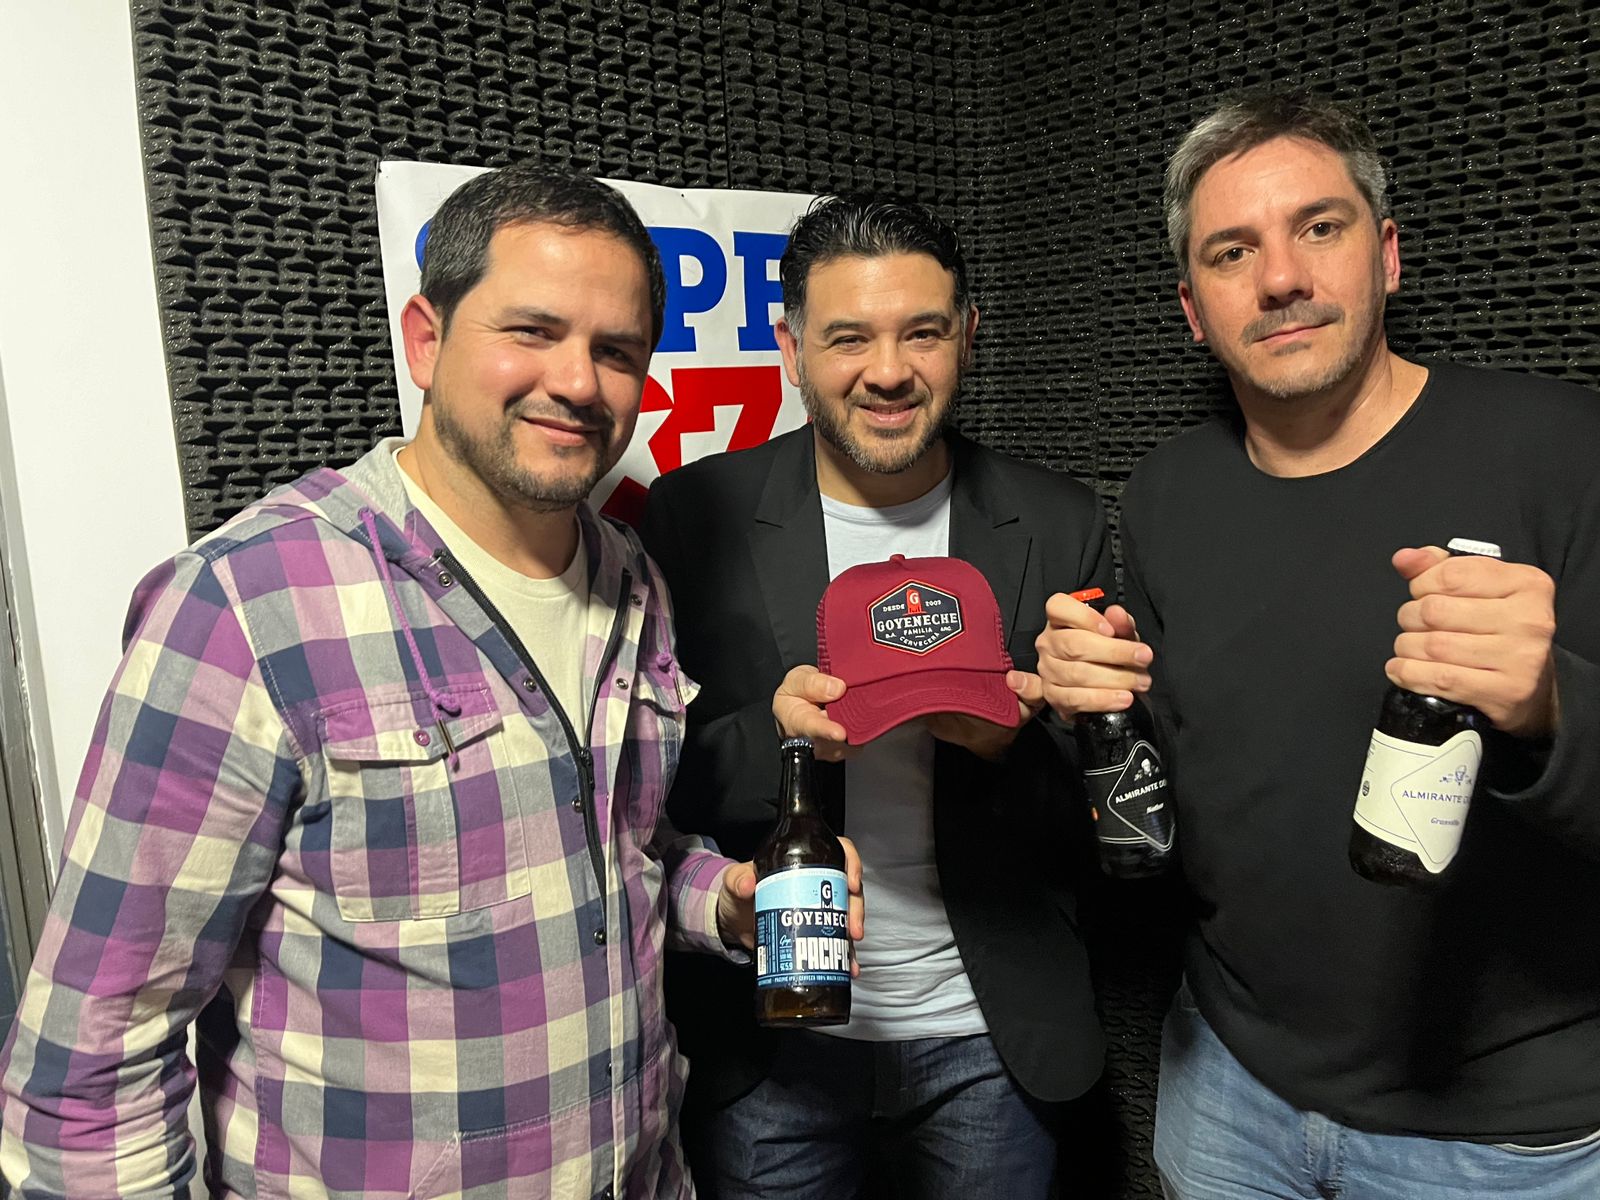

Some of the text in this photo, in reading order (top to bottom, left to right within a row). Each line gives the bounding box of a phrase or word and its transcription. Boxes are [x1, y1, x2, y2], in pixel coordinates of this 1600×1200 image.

[910, 593, 919, 605] G
[883, 604, 905, 612] DESDE
[877, 613, 958, 632] GOYENECHE
[1115, 782, 1158, 803] ALMIRANTE
[1402, 790, 1463, 804] ALMIRANTE
[822, 884, 832, 899] G
